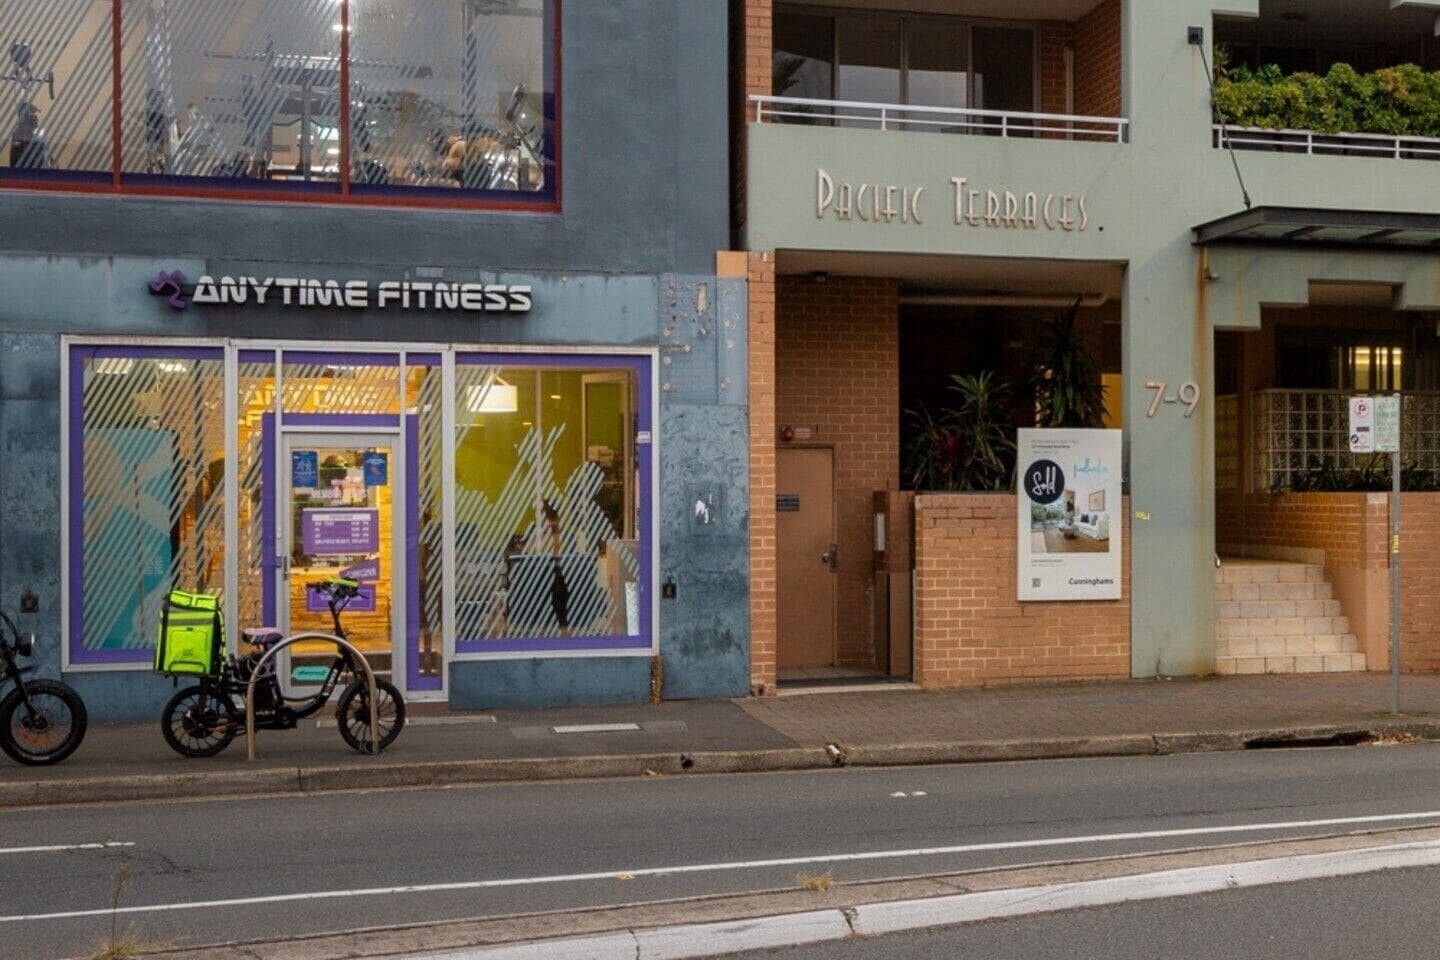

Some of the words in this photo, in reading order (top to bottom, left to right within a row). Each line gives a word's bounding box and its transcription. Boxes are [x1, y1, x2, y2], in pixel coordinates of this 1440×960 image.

[816, 168, 924, 225] PACIFIC
[950, 176, 1088, 232] TERRACES
[191, 275, 369, 308] ANYTIME
[378, 281, 533, 312] FITNESS
[1145, 381, 1200, 418] 7-9
[1032, 466, 1057, 496] Sold
[1069, 577, 1114, 586] Cunninghams
